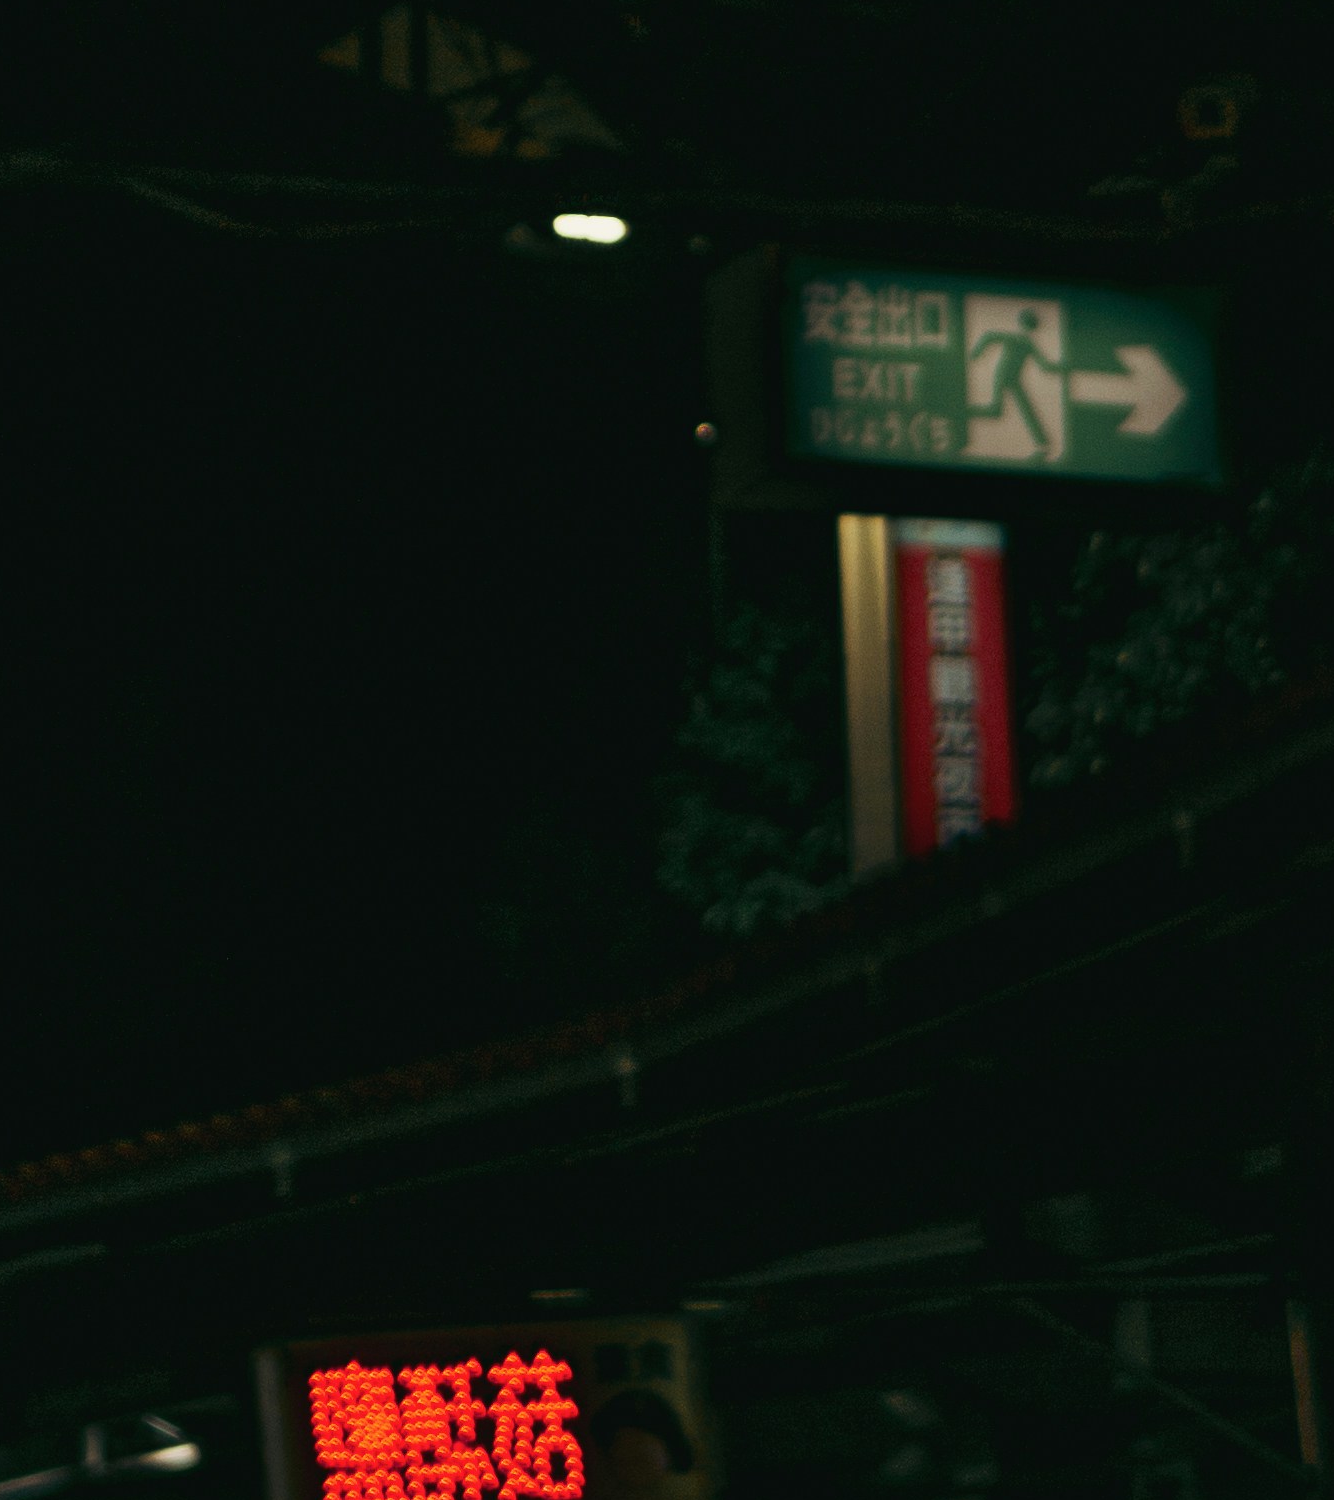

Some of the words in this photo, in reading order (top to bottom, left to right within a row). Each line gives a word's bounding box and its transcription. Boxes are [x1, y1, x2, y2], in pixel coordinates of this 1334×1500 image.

[800, 279, 951, 349] 安全出口
[831, 356, 923, 404] EXIT
